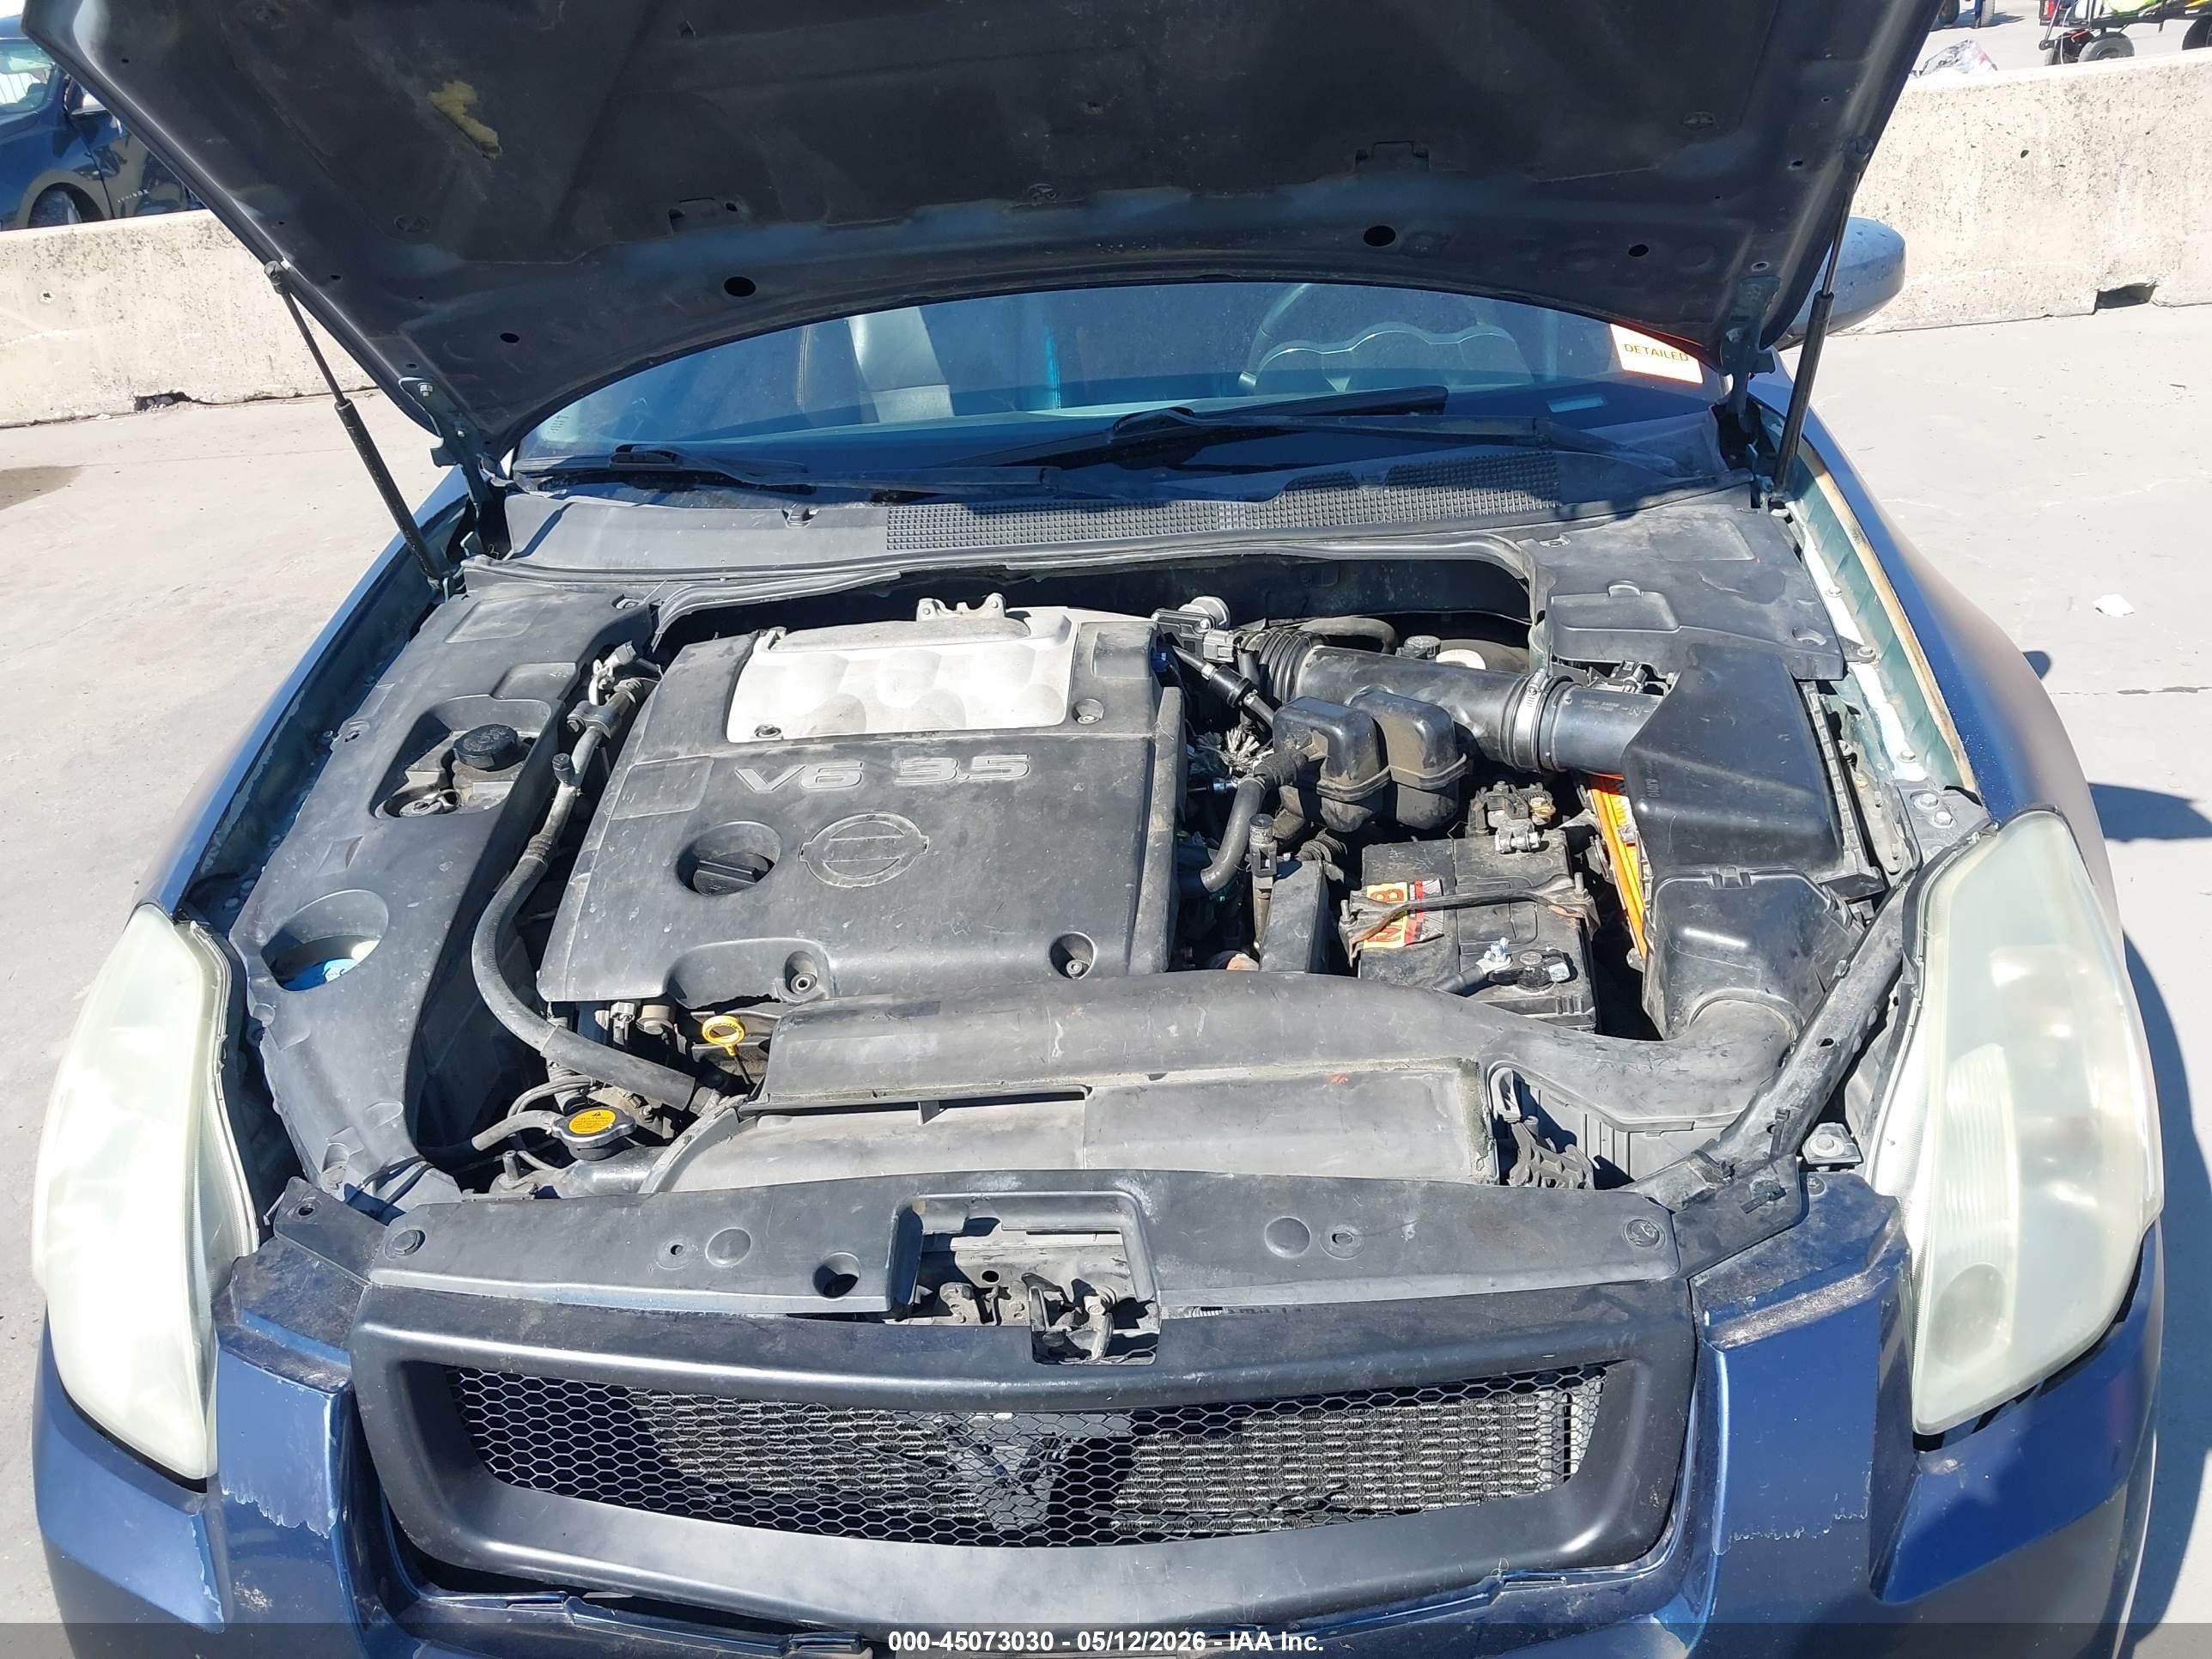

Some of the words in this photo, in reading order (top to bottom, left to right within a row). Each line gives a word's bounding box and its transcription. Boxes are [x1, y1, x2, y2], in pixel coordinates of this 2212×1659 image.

[1624, 343, 1689, 362] DETAILED
[735, 762, 864, 793] V6
[895, 754, 1030, 784] 3.5
